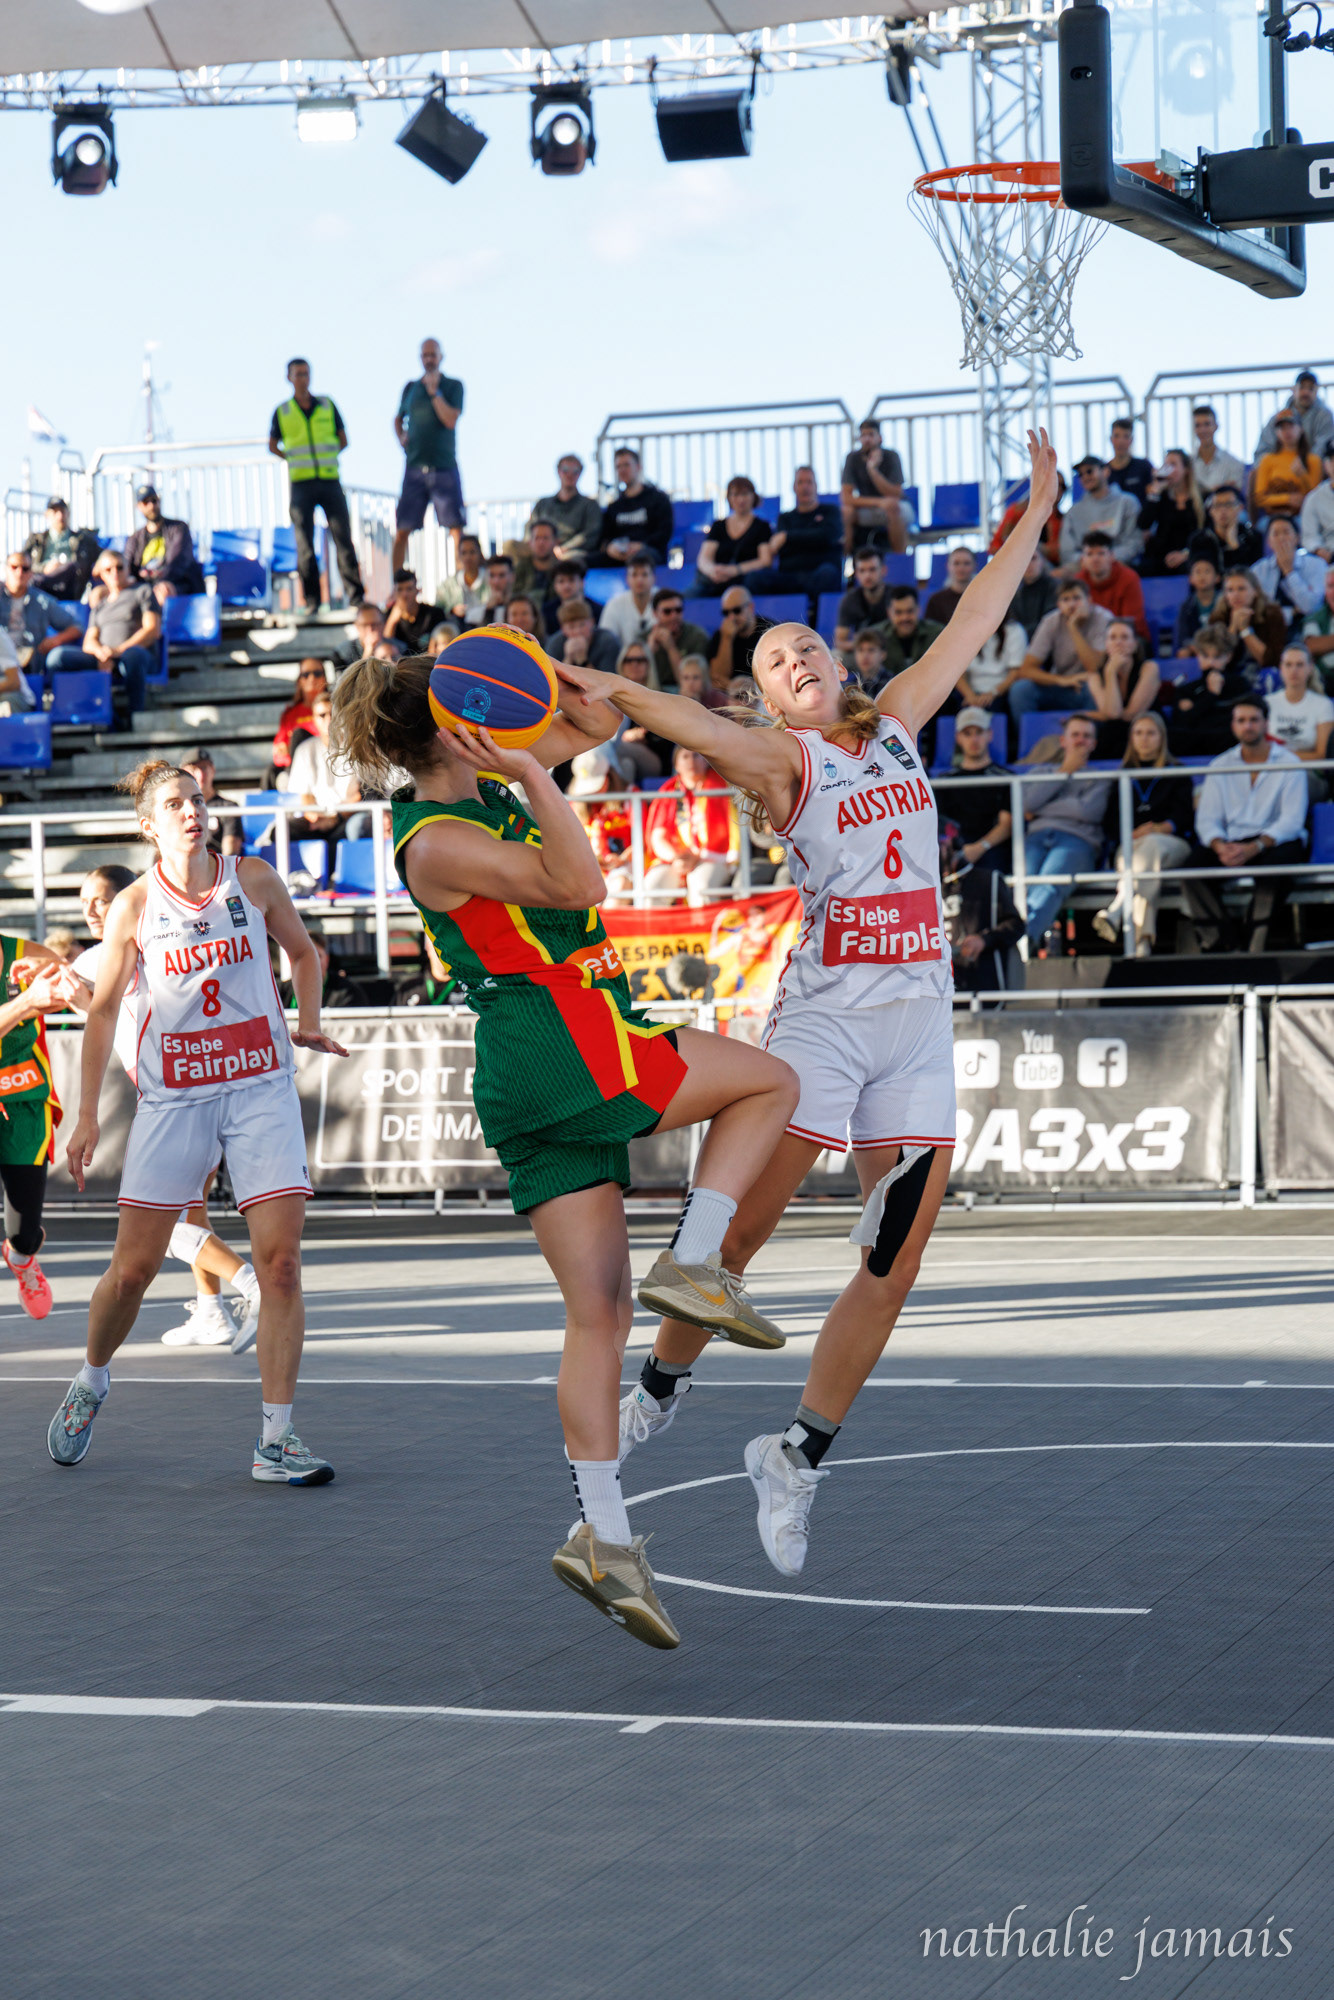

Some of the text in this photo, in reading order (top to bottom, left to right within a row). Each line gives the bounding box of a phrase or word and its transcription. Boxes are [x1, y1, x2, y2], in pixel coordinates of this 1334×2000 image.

[820, 780, 847, 792] CRAFT
[837, 777, 933, 835] AUSTRIA
[884, 829, 903, 880] 6
[829, 900, 900, 927] Es lebe
[165, 935, 254, 976] AUSTRIA
[201, 979, 222, 1018] 8
[163, 1035, 223, 1055] Es lebe
[1021, 1029, 1055, 1053] You
[173, 1045, 273, 1081] Fairplay
[1020, 1060, 1059, 1081] Tube
[0, 1069, 38, 1090] son
[360, 1067, 457, 1097] SPORT
